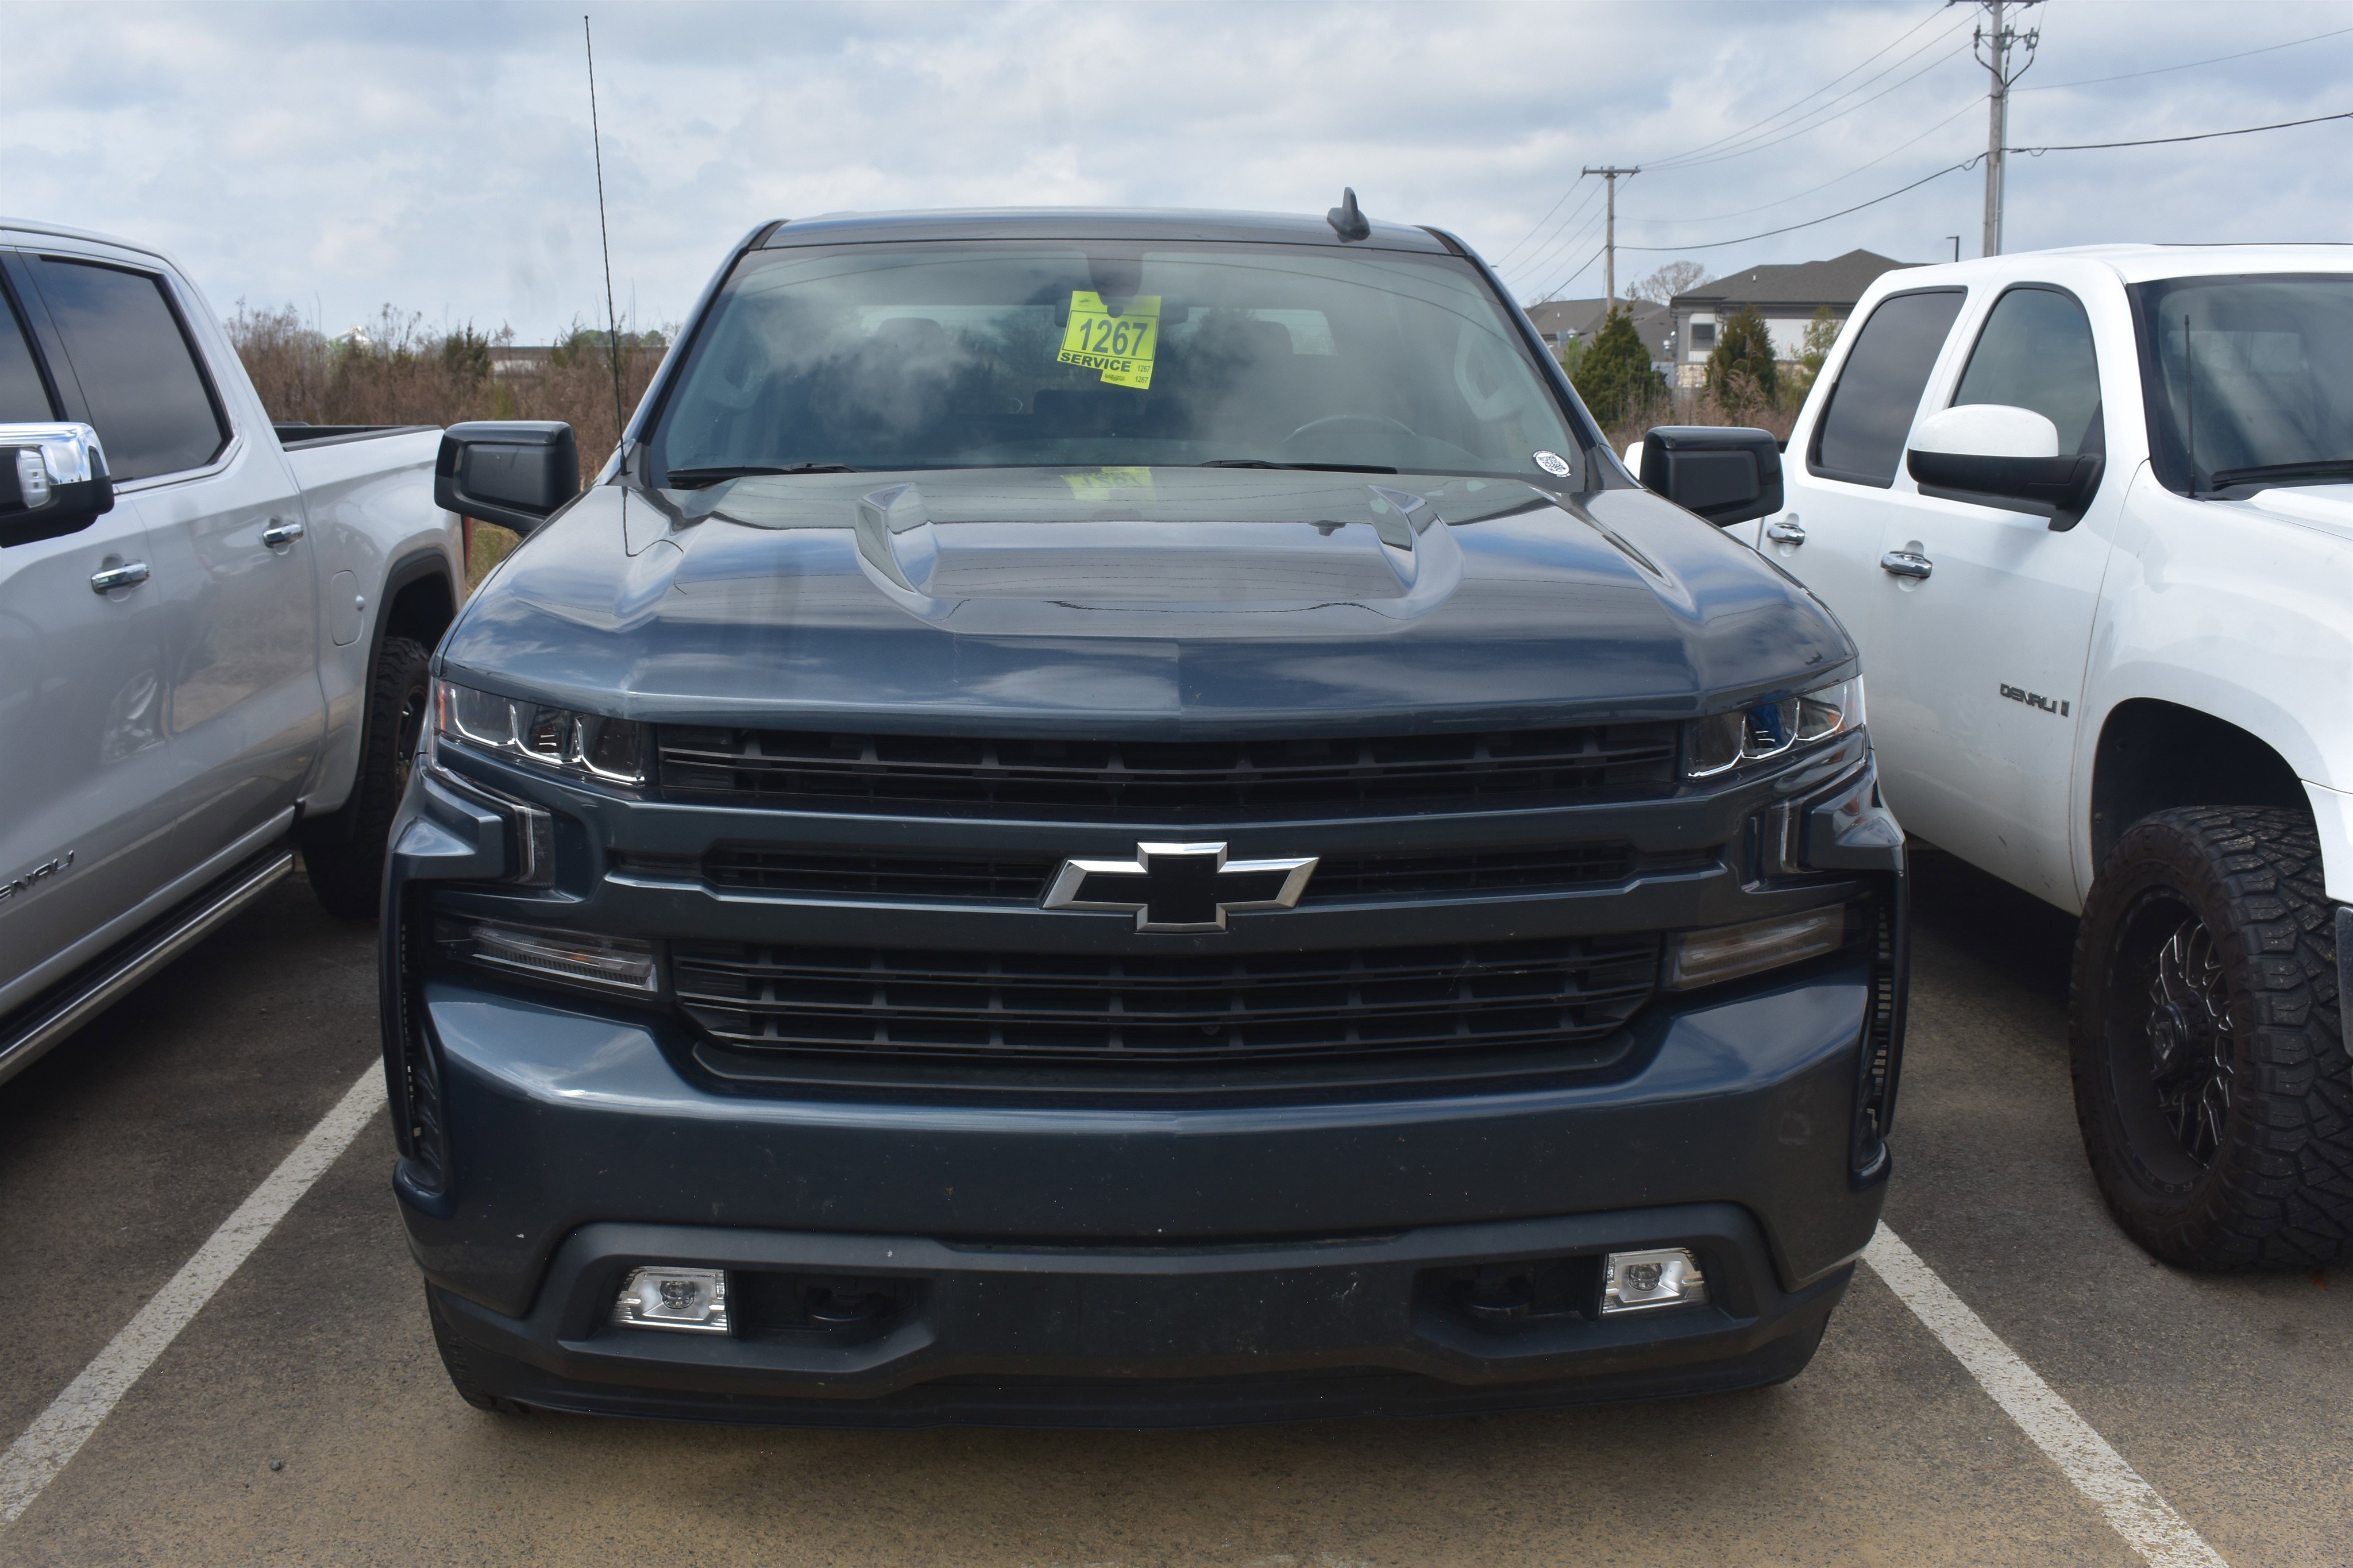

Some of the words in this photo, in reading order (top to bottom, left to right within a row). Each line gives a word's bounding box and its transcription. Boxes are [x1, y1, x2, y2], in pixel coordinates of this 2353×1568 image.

[1080, 318, 1148, 356] 1267
[1060, 352, 1132, 372] SERVICE
[2000, 683, 2057, 714] DENALI
[0, 850, 74, 903] ENALI
